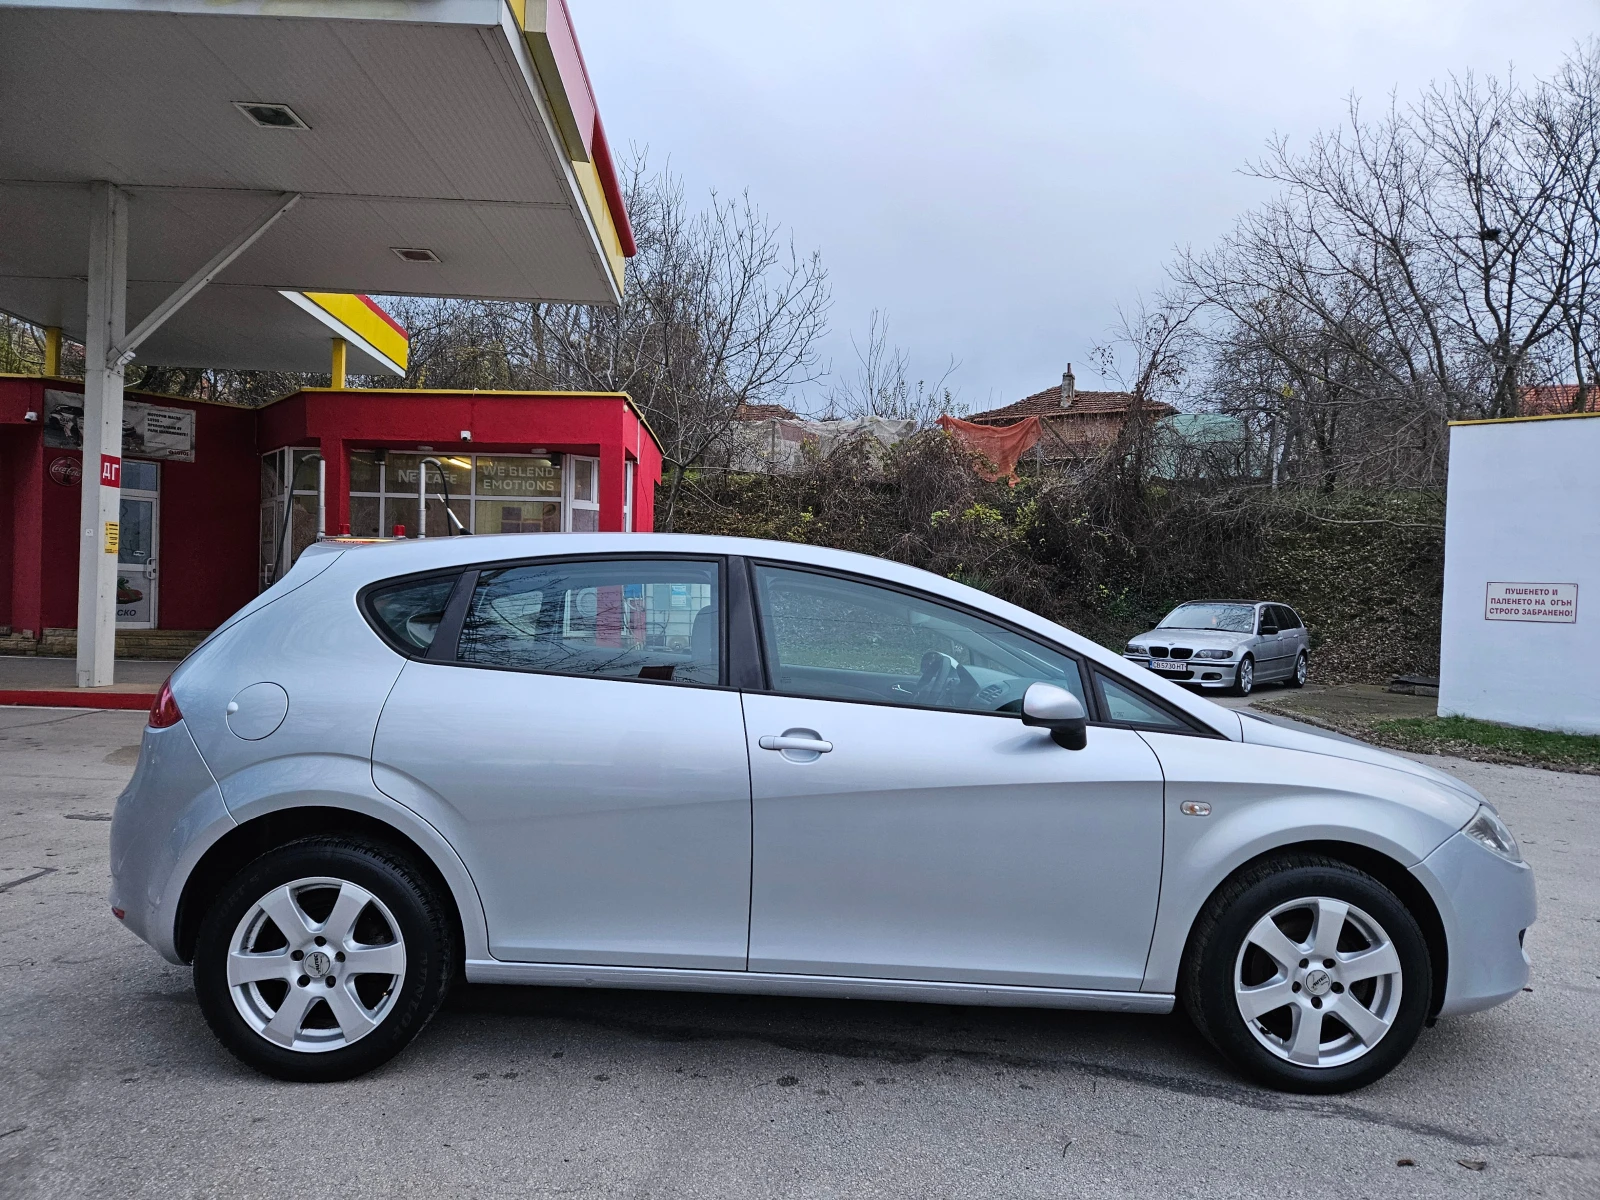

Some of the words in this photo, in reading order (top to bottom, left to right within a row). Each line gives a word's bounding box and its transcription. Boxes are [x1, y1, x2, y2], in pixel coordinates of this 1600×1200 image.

[398, 470, 457, 484] NECAFE
[483, 466, 506, 476] WE
[510, 466, 554, 477] BLEND
[483, 480, 554, 491] EMOTIONS
